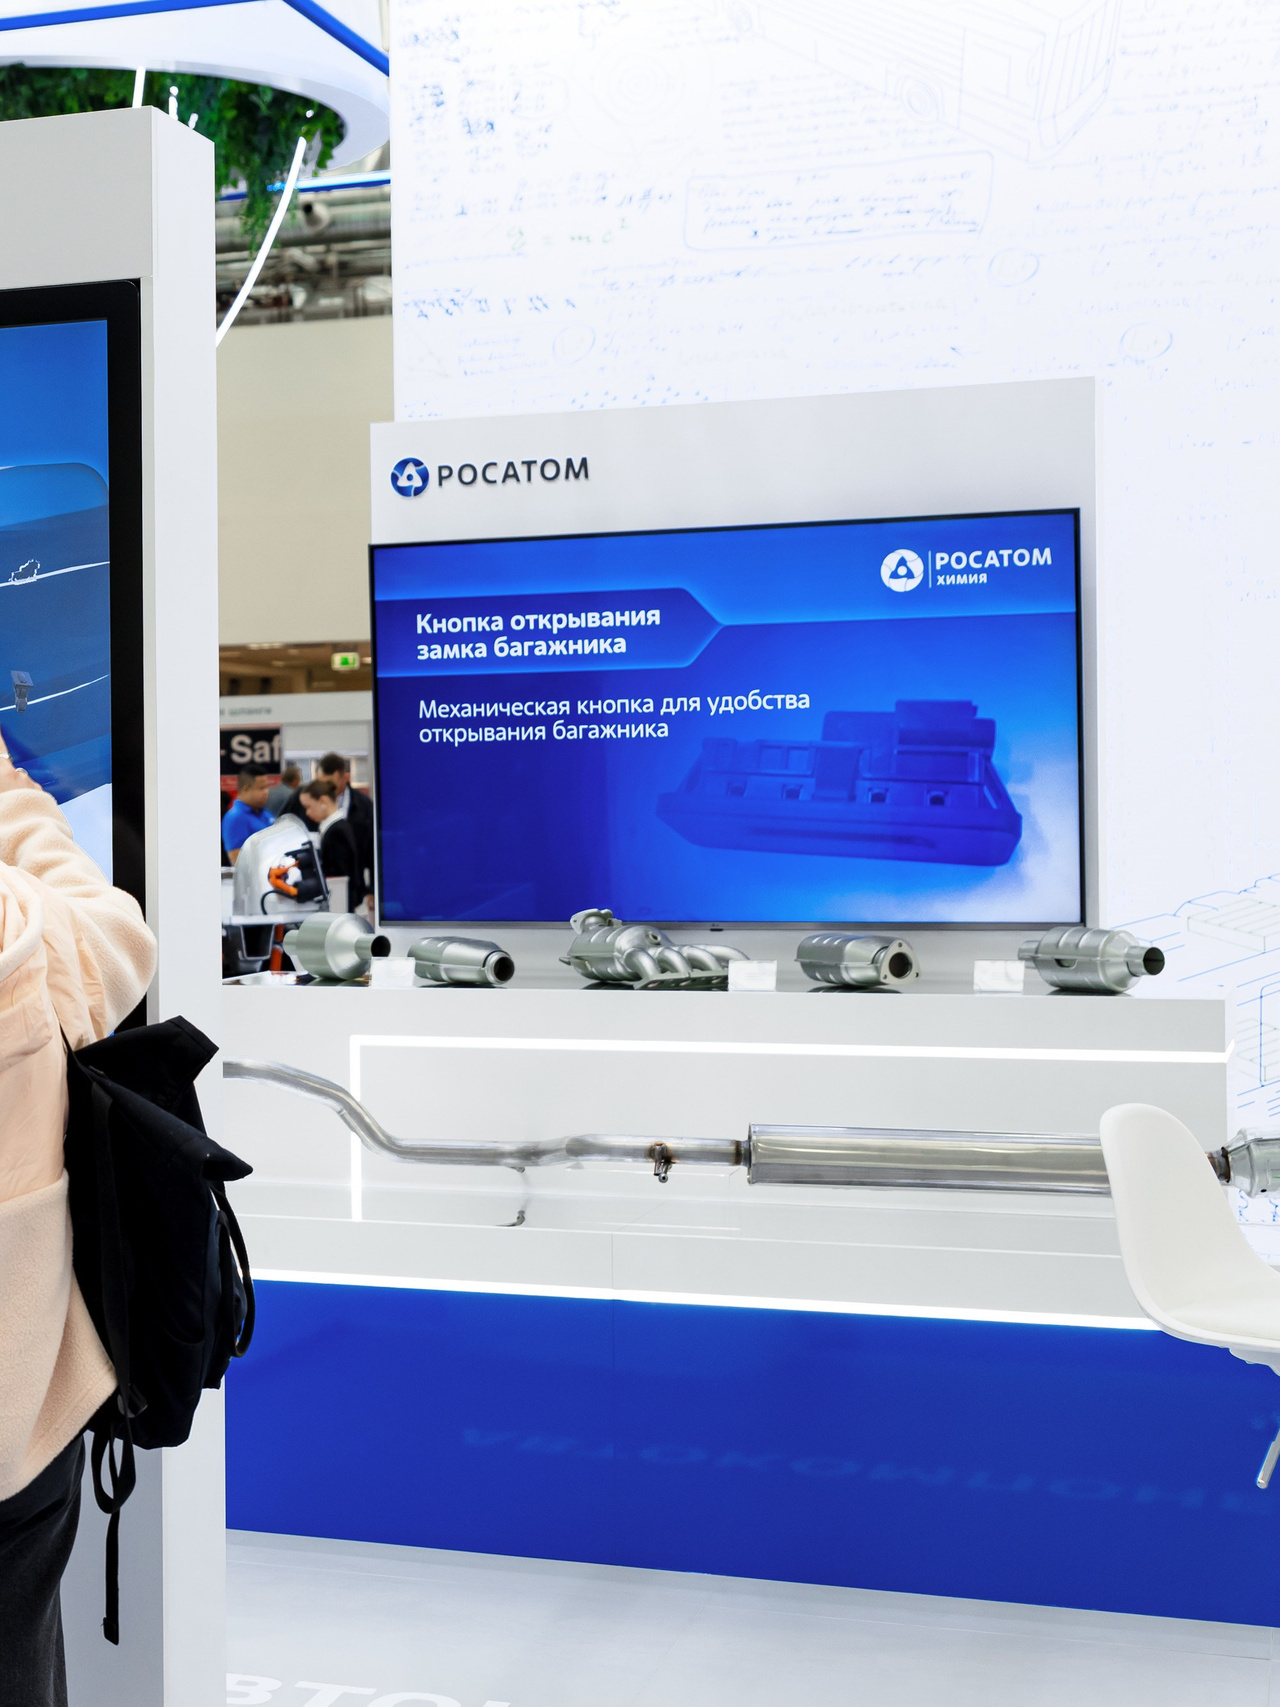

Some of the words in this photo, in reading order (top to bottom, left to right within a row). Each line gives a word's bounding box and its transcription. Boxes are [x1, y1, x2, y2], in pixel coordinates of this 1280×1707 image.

[437, 457, 589, 487] РОСАТОМ
[935, 547, 1053, 570] РОСАТОМ
[936, 573, 988, 586] ХИМИЯ
[416, 613, 504, 634] Кнопка
[510, 609, 661, 634] открывания
[417, 641, 487, 660] замка
[493, 636, 627, 657] багажника
[419, 700, 570, 719] Механическая
[577, 698, 654, 715] кнопка
[660, 697, 701, 716] для
[707, 689, 810, 716] удобства
[419, 725, 546, 747] открывания
[552, 720, 669, 740] багажника
